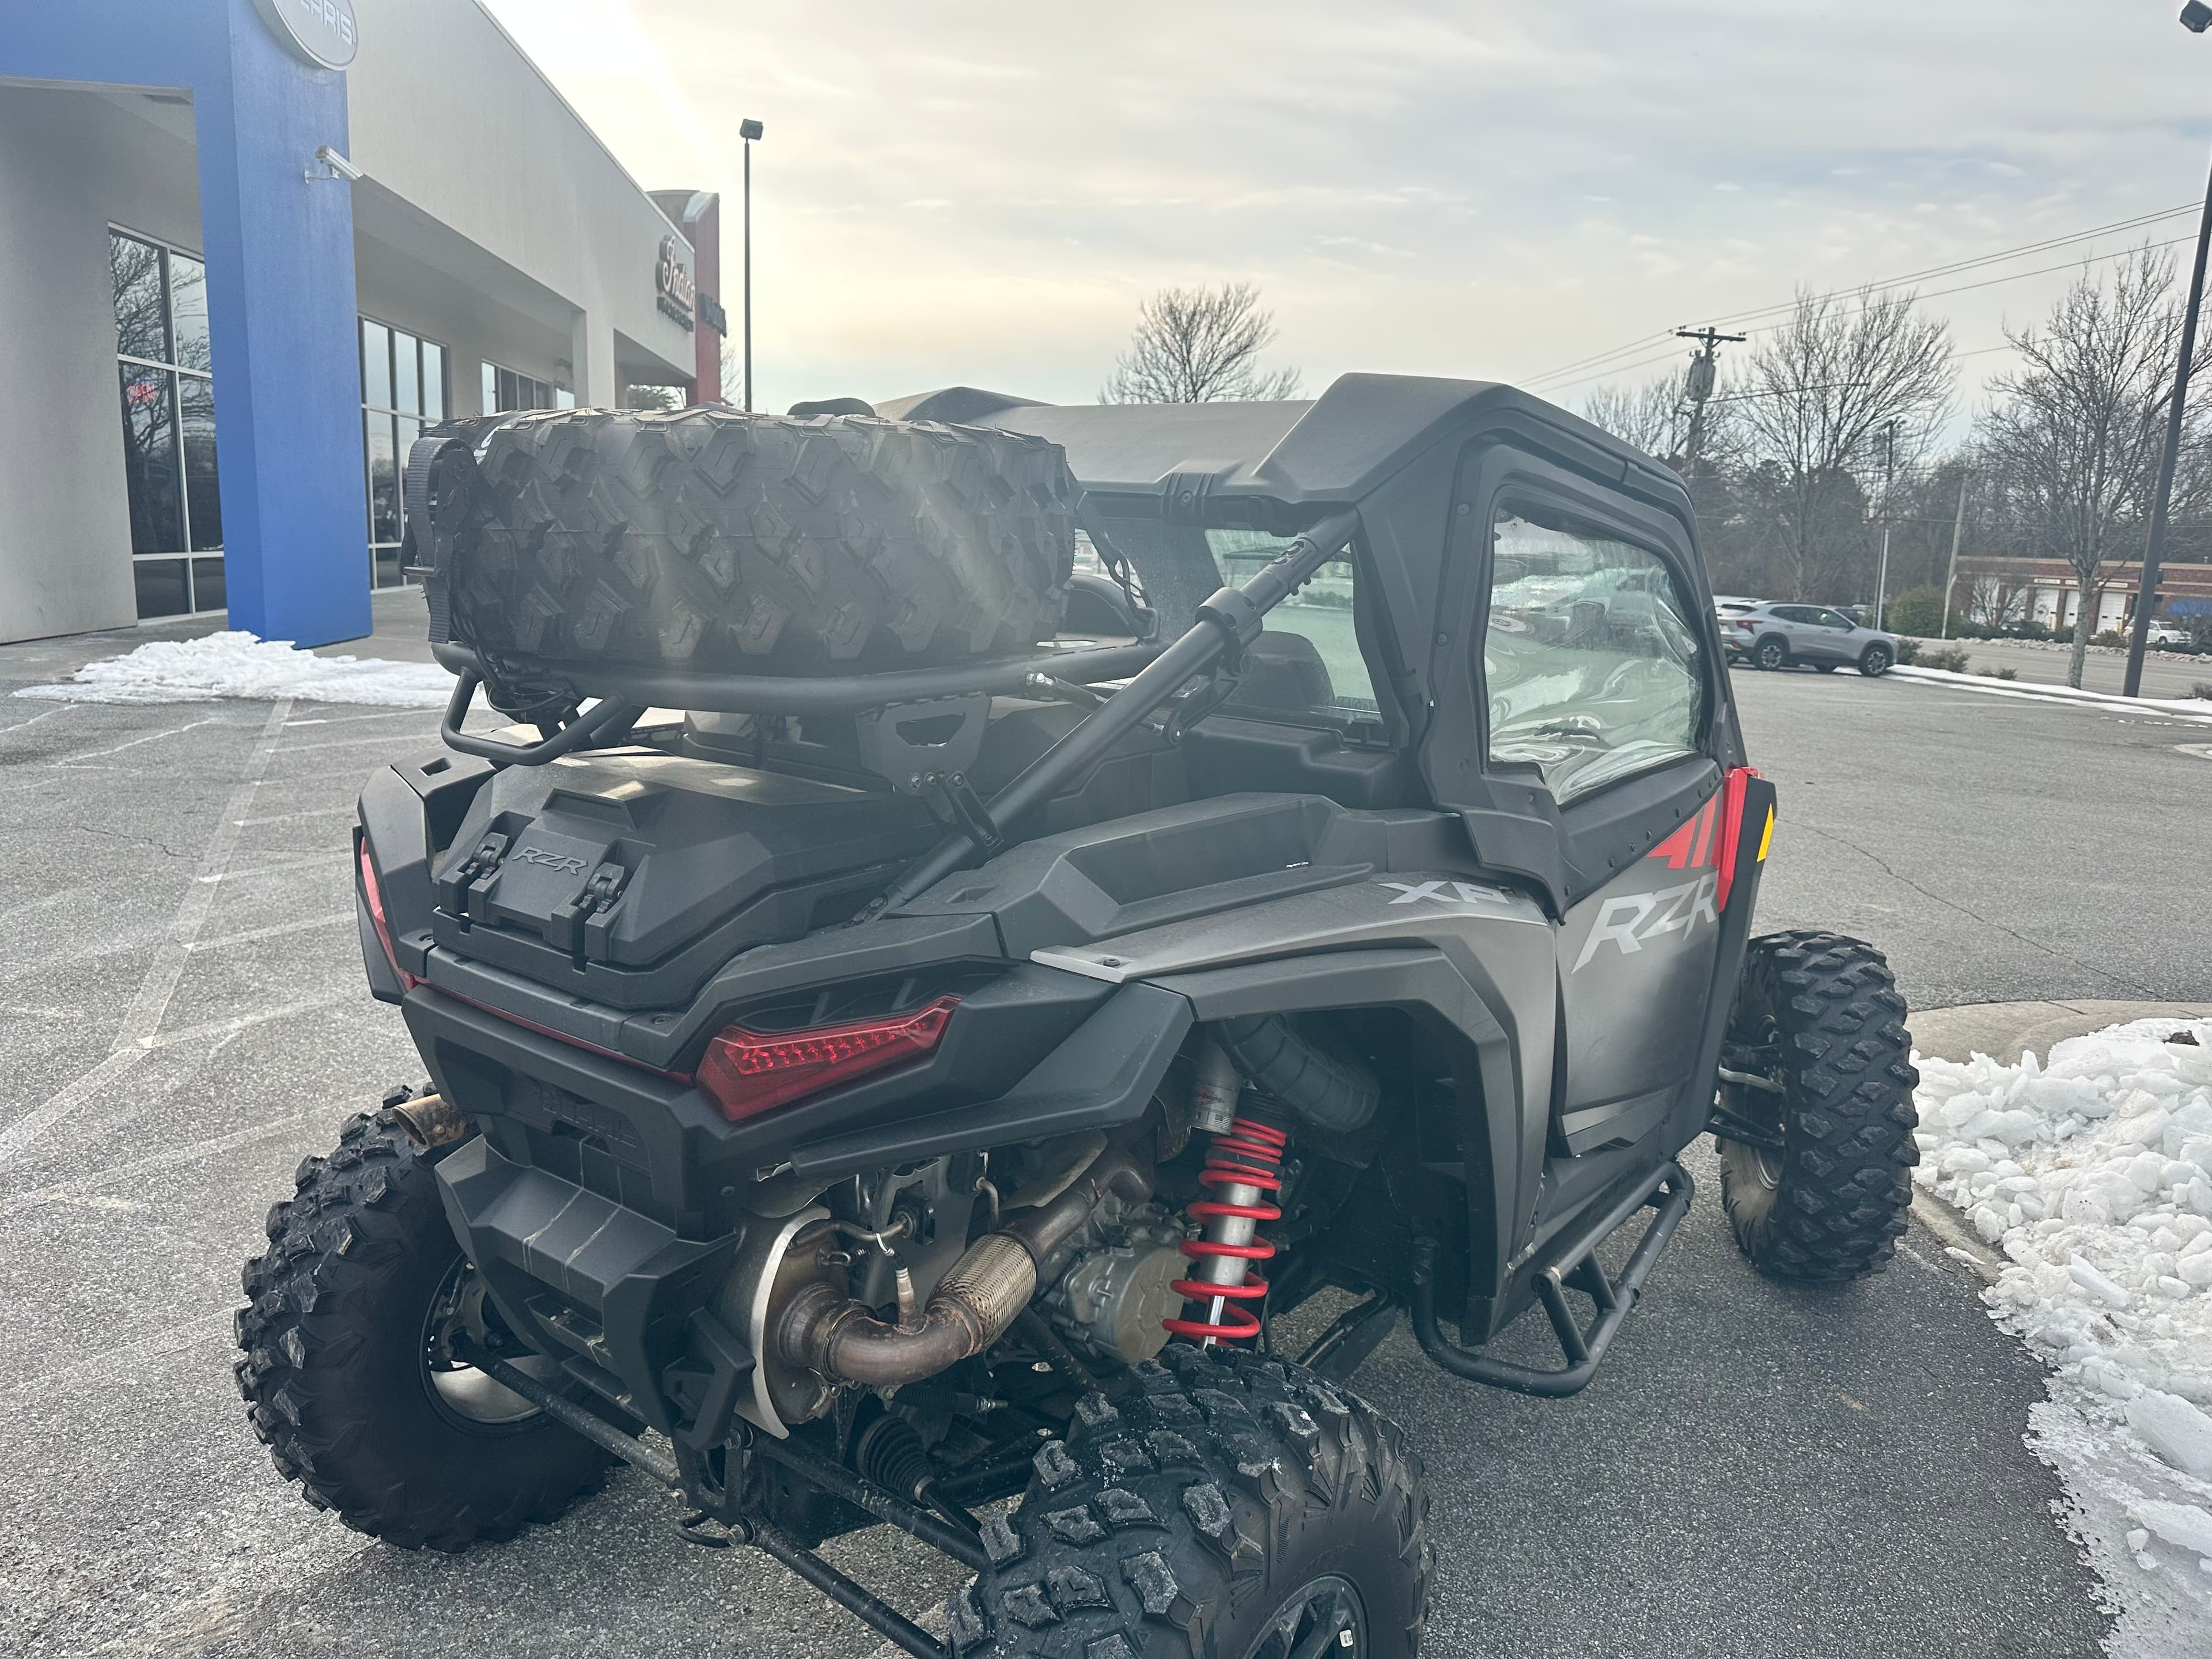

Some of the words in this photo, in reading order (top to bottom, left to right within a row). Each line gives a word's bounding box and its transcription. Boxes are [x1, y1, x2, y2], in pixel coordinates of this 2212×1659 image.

[127, 384, 155, 404] OPEN
[512, 846, 588, 876] RZR
[1571, 869, 1719, 975] RZR
